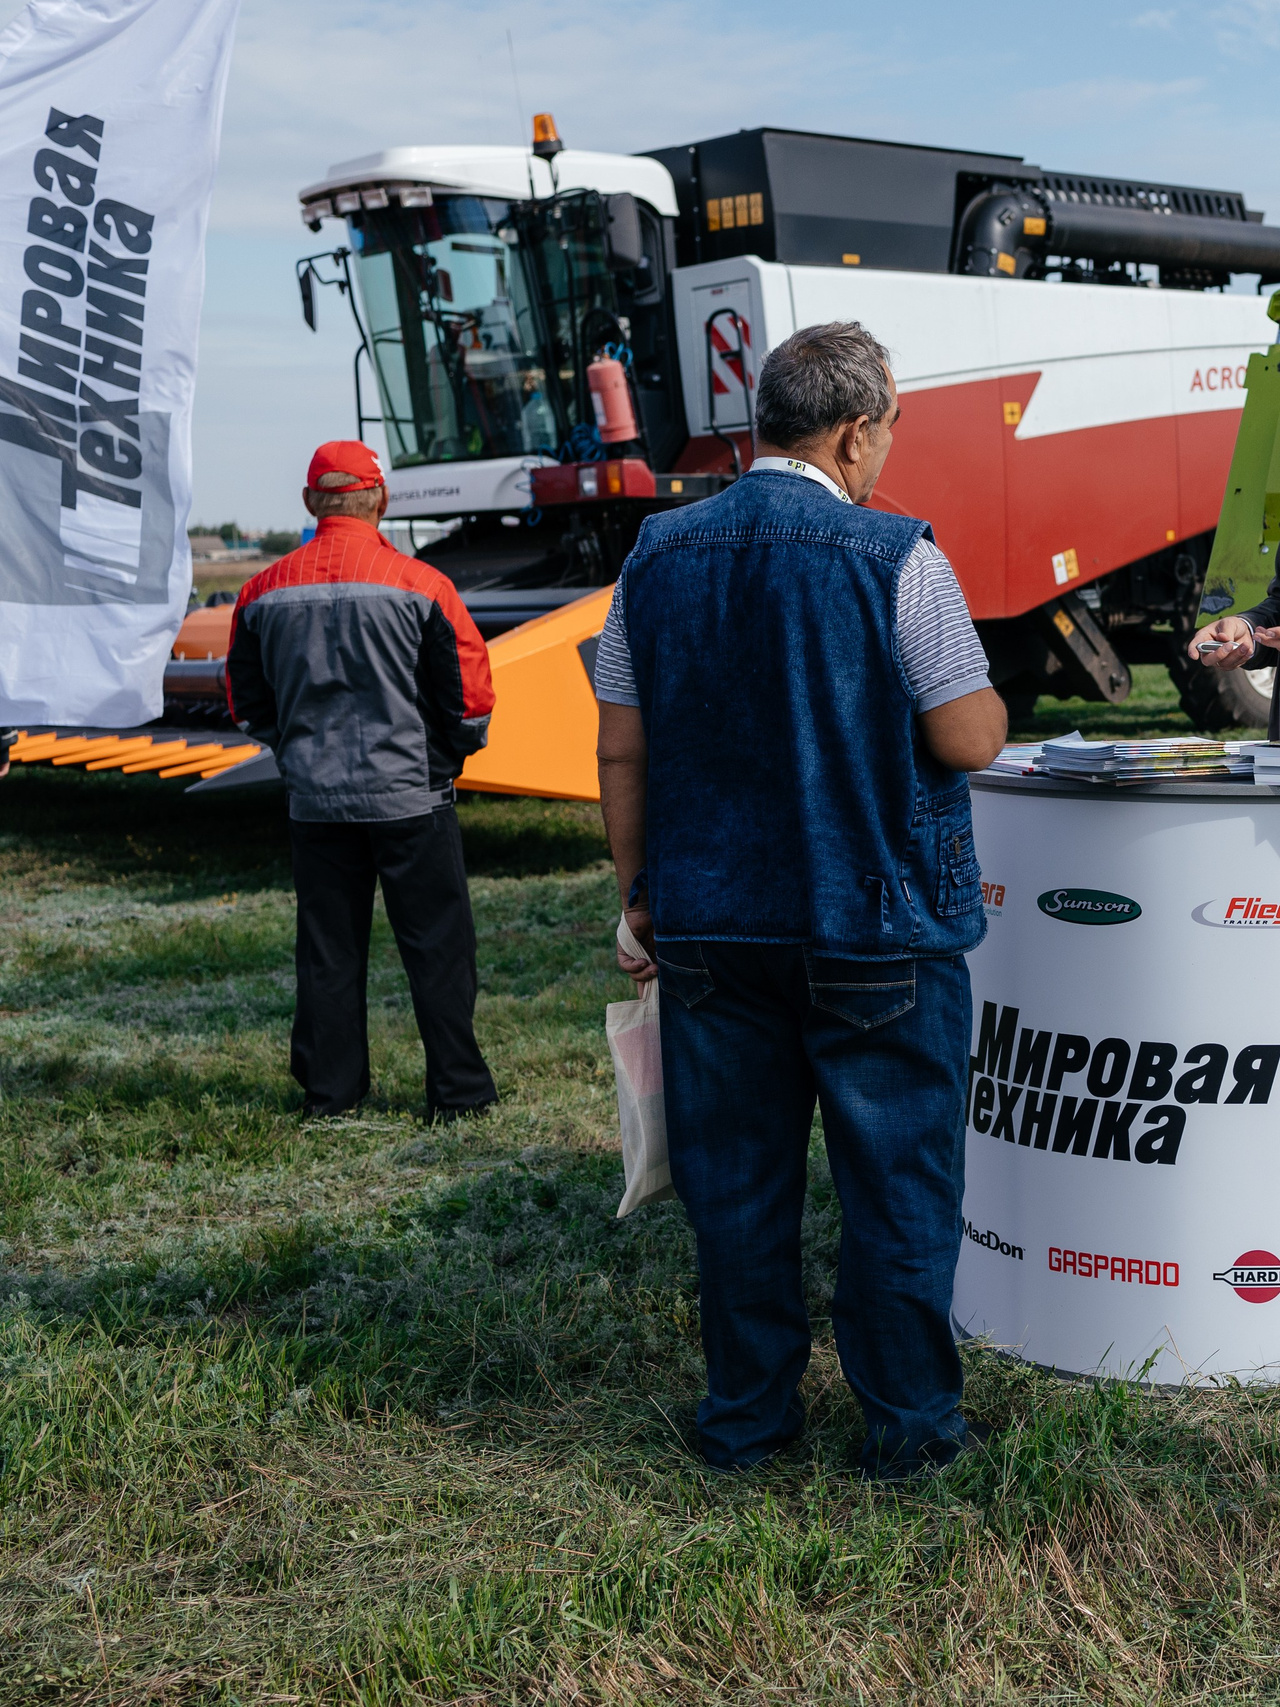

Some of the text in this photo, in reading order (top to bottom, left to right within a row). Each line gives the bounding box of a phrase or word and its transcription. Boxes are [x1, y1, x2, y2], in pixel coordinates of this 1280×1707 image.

[61, 198, 155, 511] Техника
[980, 881, 1006, 907] ara
[1045, 890, 1133, 913] Samson
[962, 1216, 1024, 1261] MacDon
[1049, 1246, 1180, 1288] GASPARDO
